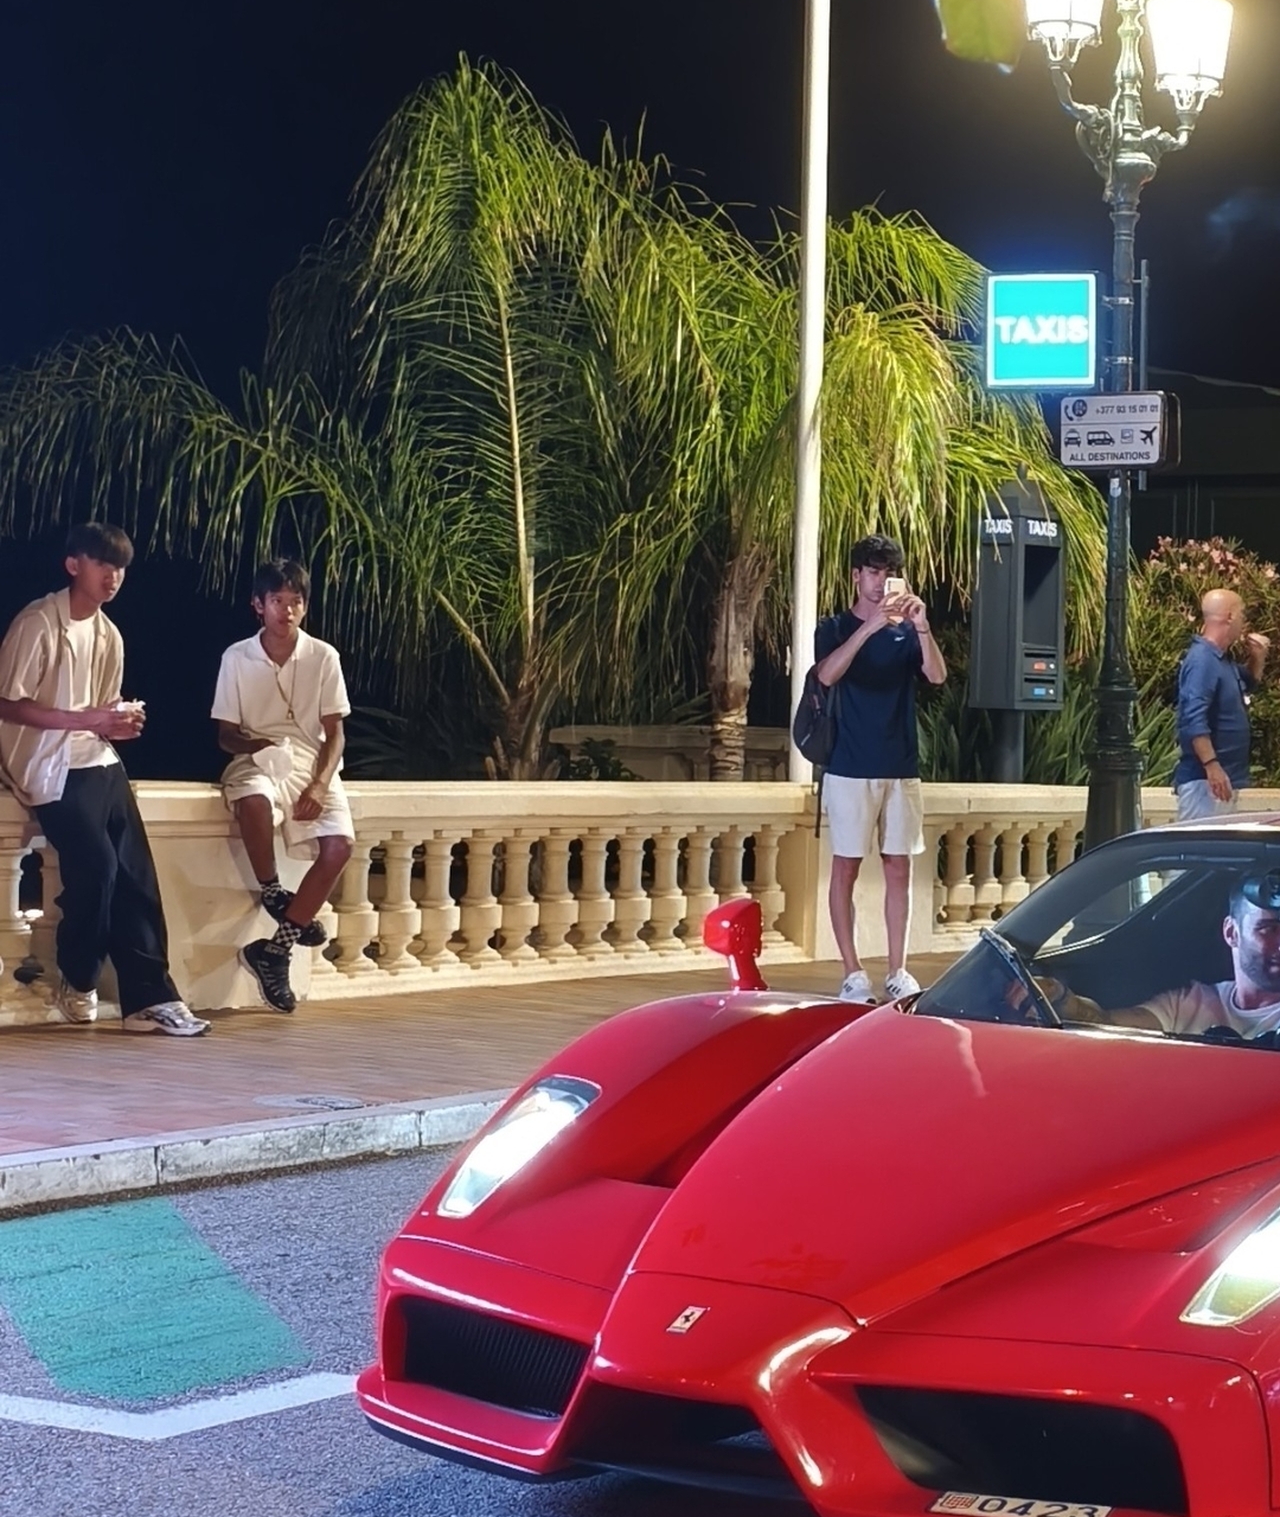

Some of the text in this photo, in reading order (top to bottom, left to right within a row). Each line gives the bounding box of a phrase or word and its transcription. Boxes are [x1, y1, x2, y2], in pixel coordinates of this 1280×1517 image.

[995, 314, 1089, 345] TAXIS
[1096, 404, 1159, 414] +377 93 15 01 01
[1069, 451, 1151, 462] ALL DESTINATIONS
[984, 518, 1012, 534] TAXIS
[1027, 519, 1057, 537] TAXIS
